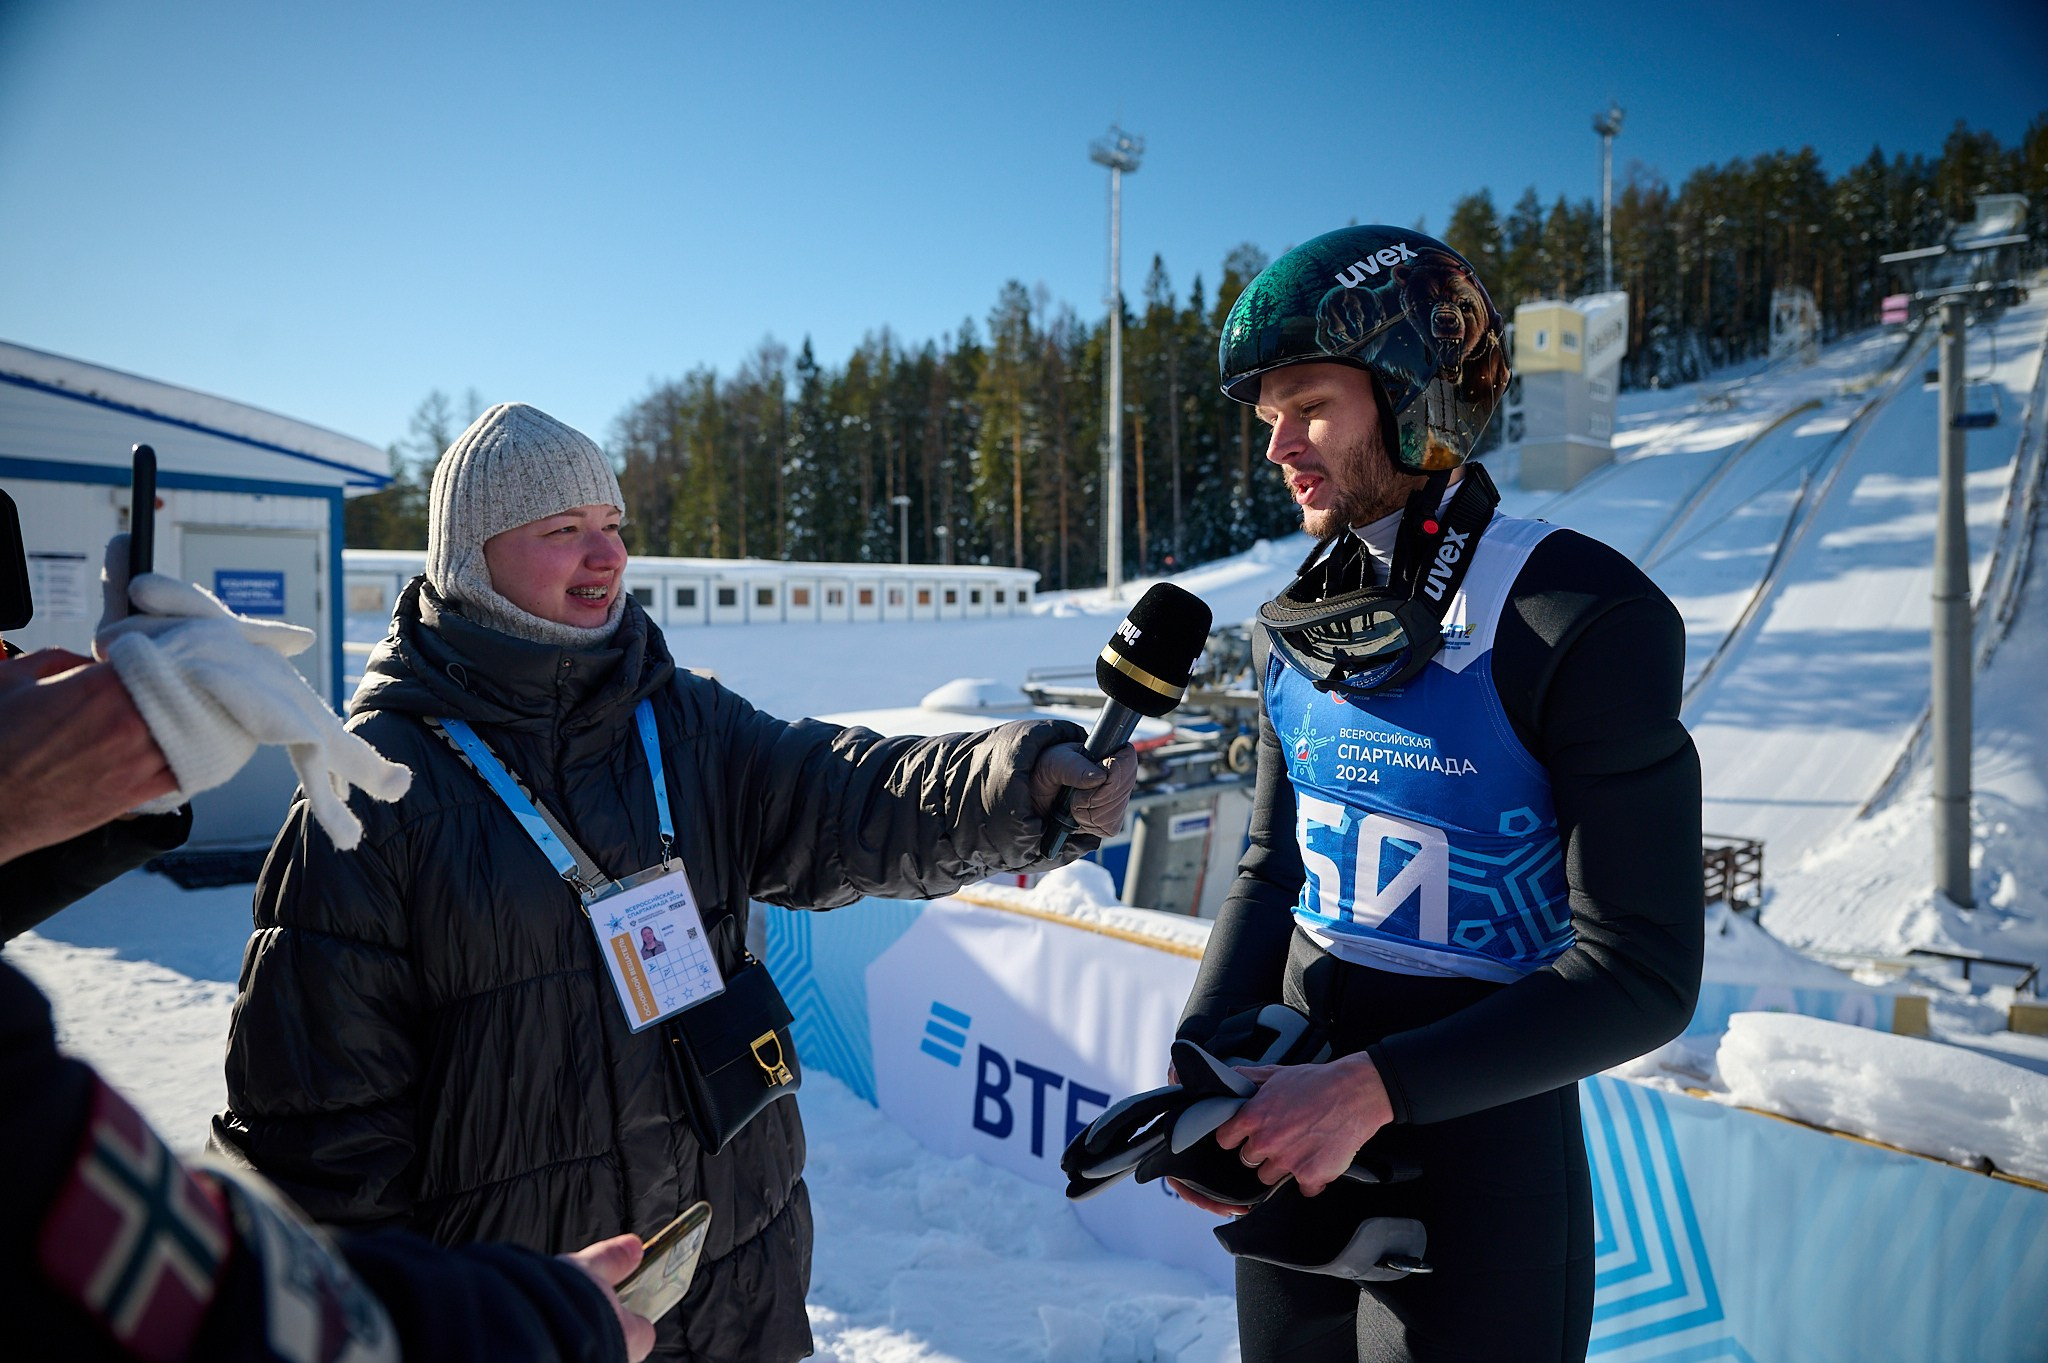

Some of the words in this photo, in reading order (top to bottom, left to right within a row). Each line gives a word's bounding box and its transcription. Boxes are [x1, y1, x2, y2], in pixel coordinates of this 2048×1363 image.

[1334, 242, 1419, 289] uvex
[1423, 526, 1471, 602] uvex
[1339, 727, 1432, 749] ВСЕРОССИЙСКАЯ
[1335, 764, 1380, 785] 2024
[1337, 743, 1478, 776] СПАРТАКИАДА
[624, 890, 674, 914] ВСЕРОССИЙСКАЯ
[626, 898, 669, 920] СПАРТАКИАДА
[669, 893, 684, 903] 2024
[618, 937, 636, 977] ВЕЩАТЕЛЬ
[631, 975, 652, 1017] ОСНОВНОЙ
